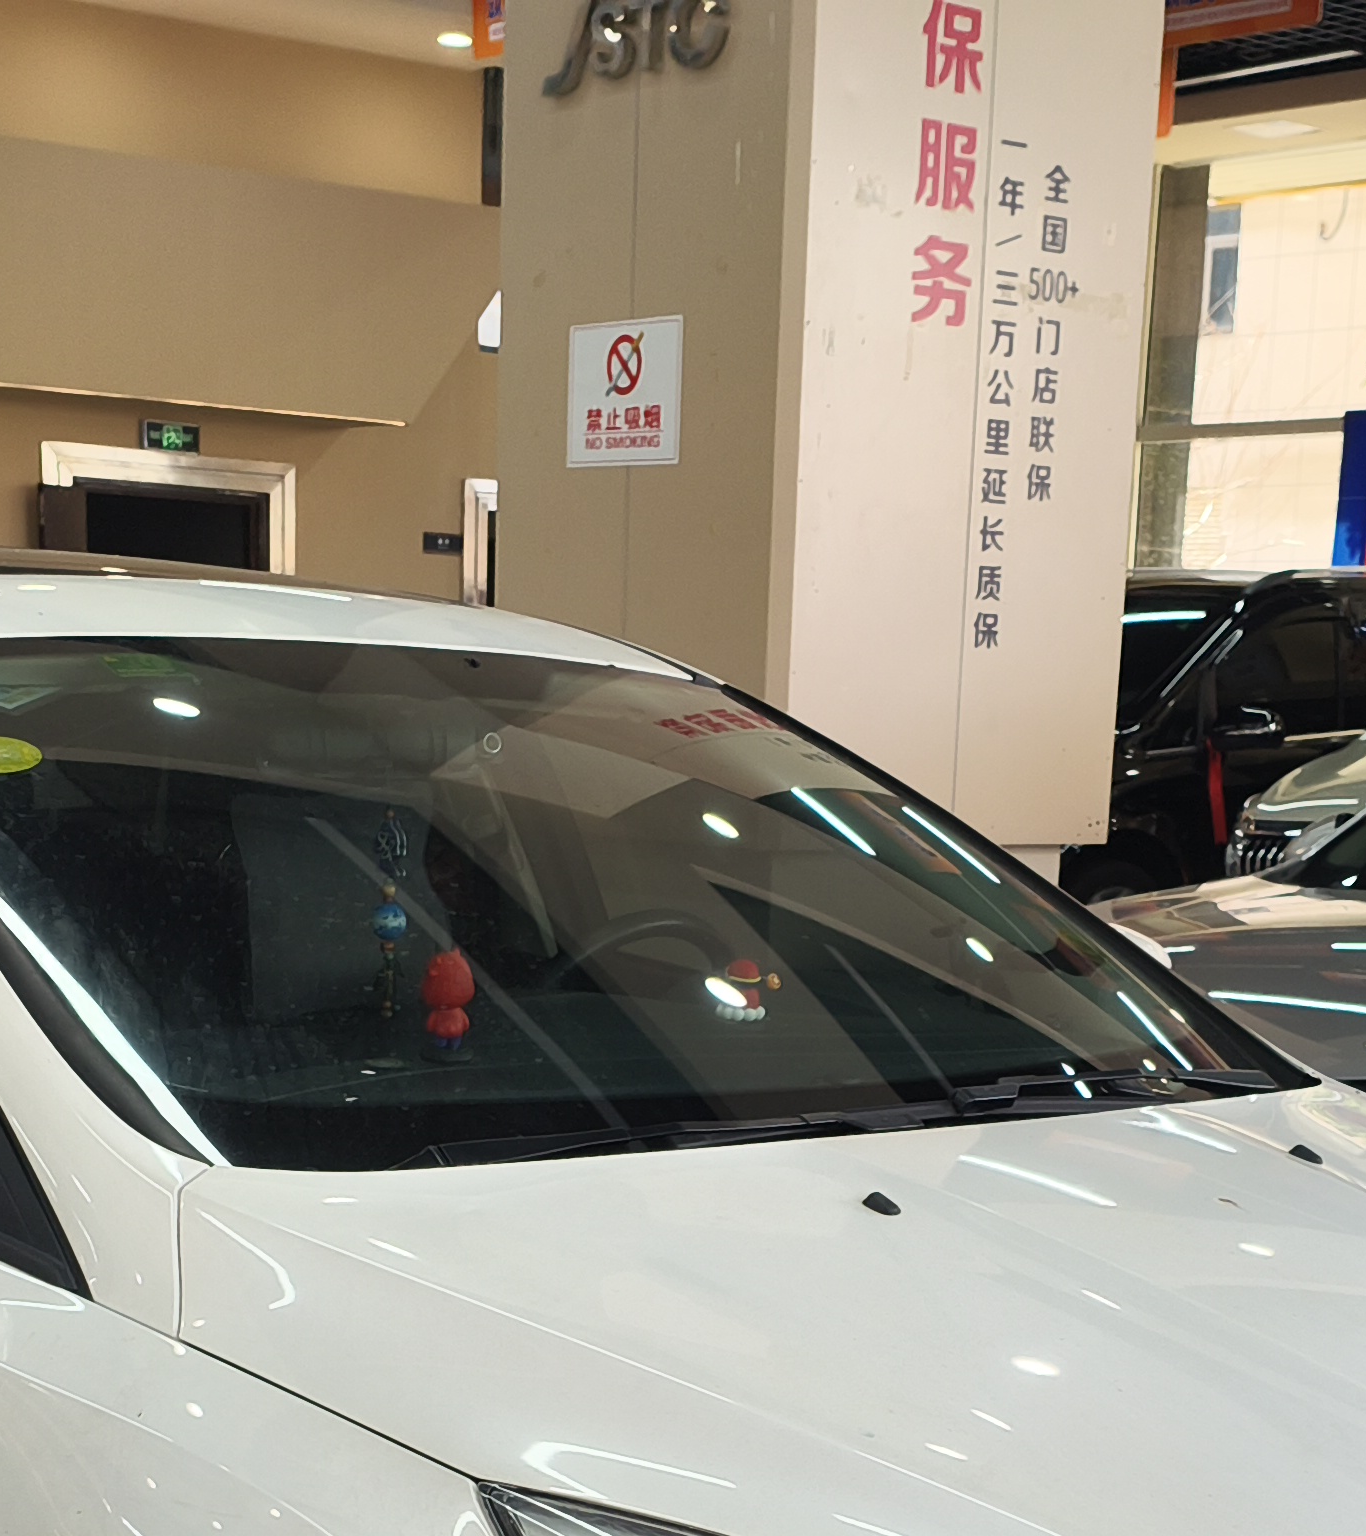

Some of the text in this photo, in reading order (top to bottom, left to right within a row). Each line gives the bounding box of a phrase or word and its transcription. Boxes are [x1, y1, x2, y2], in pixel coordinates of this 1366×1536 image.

[586, 404, 661, 433] 禁止吸烟
[585, 434, 661, 450] NO SMOKING
